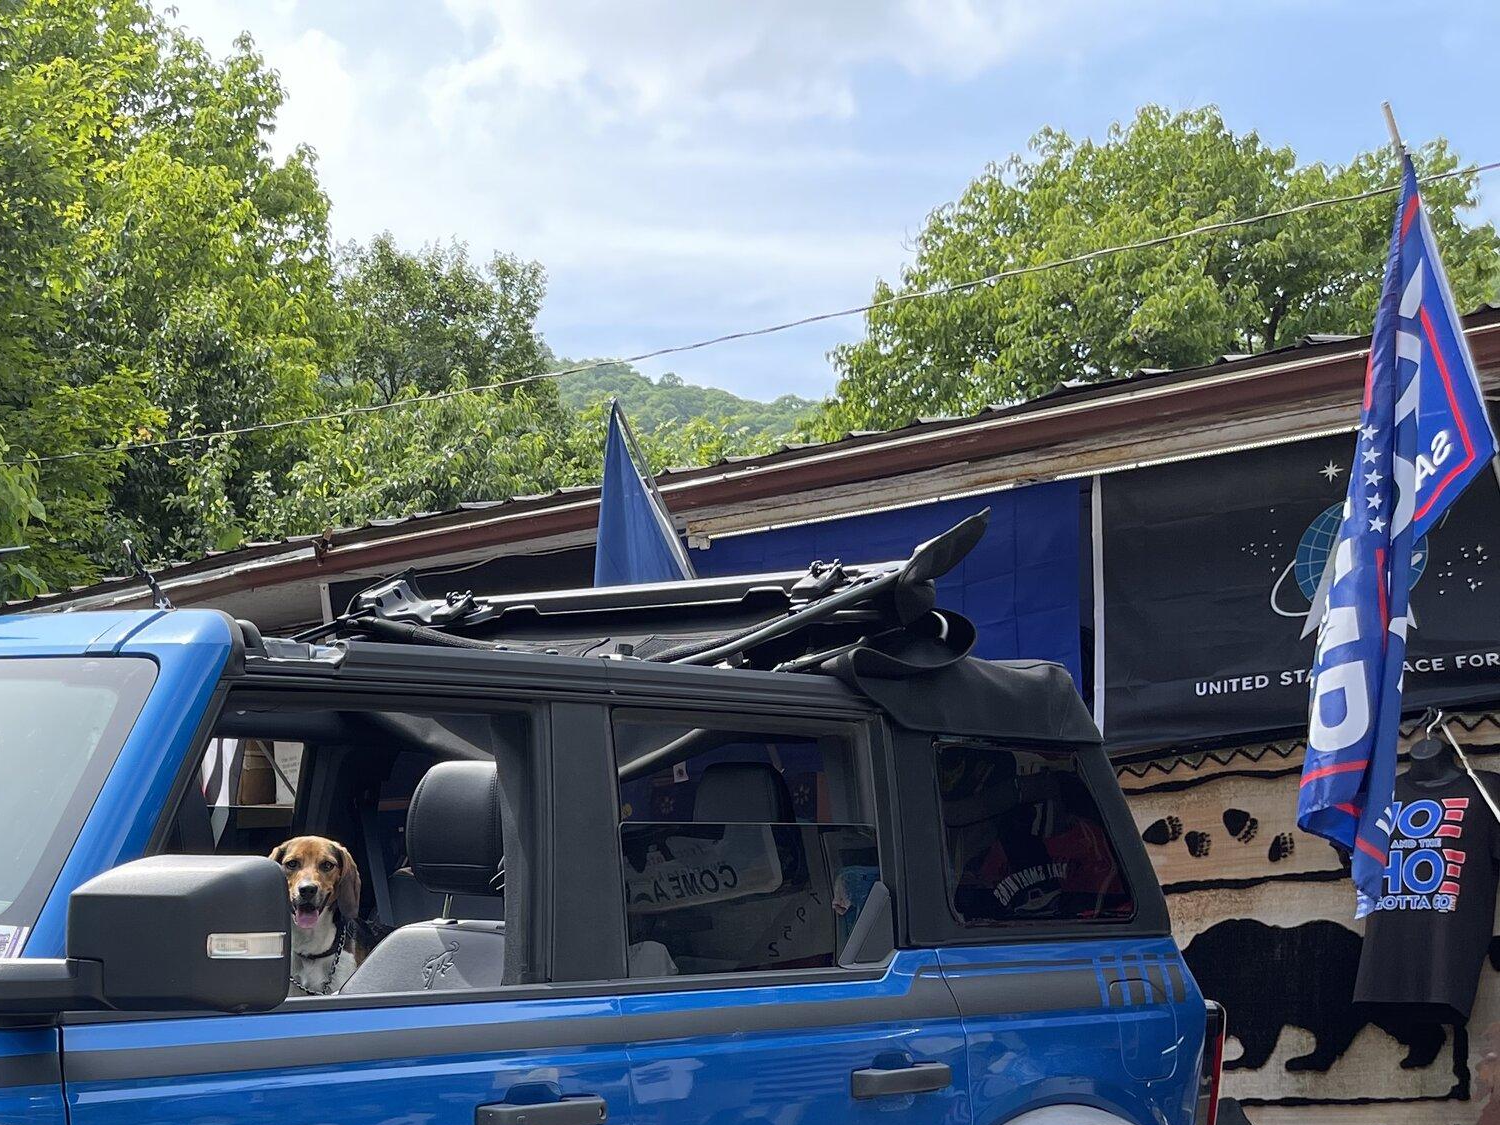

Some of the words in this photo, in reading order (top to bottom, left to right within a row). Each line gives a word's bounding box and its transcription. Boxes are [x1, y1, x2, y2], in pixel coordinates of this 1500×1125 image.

[1195, 675, 1269, 696] UNITED
[1391, 840, 1417, 849] AND
[1418, 838, 1442, 848] THE
